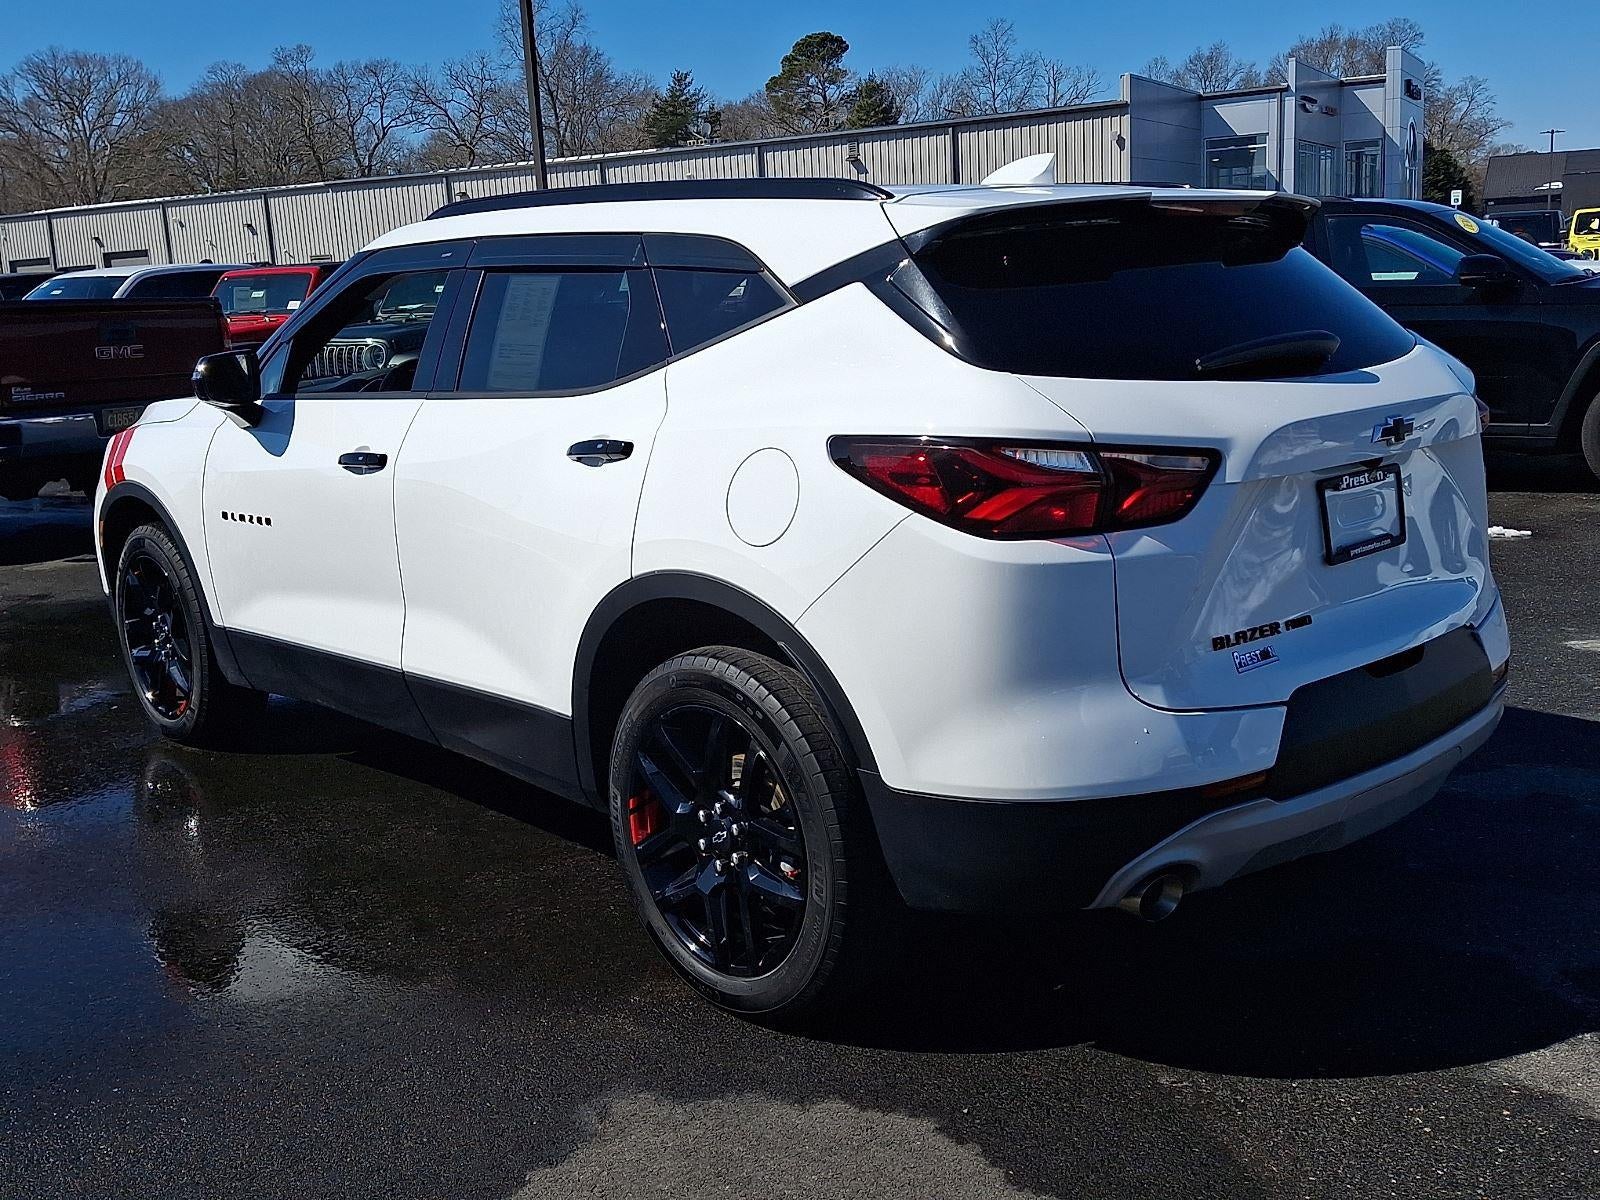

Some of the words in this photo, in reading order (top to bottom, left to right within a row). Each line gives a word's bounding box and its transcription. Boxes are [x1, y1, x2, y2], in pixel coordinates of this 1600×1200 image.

[95, 344, 144, 359] GMC
[12, 392, 65, 402] SIERRA
[221, 511, 273, 527] BLAZER
[1212, 621, 1282, 651] BLAZER
